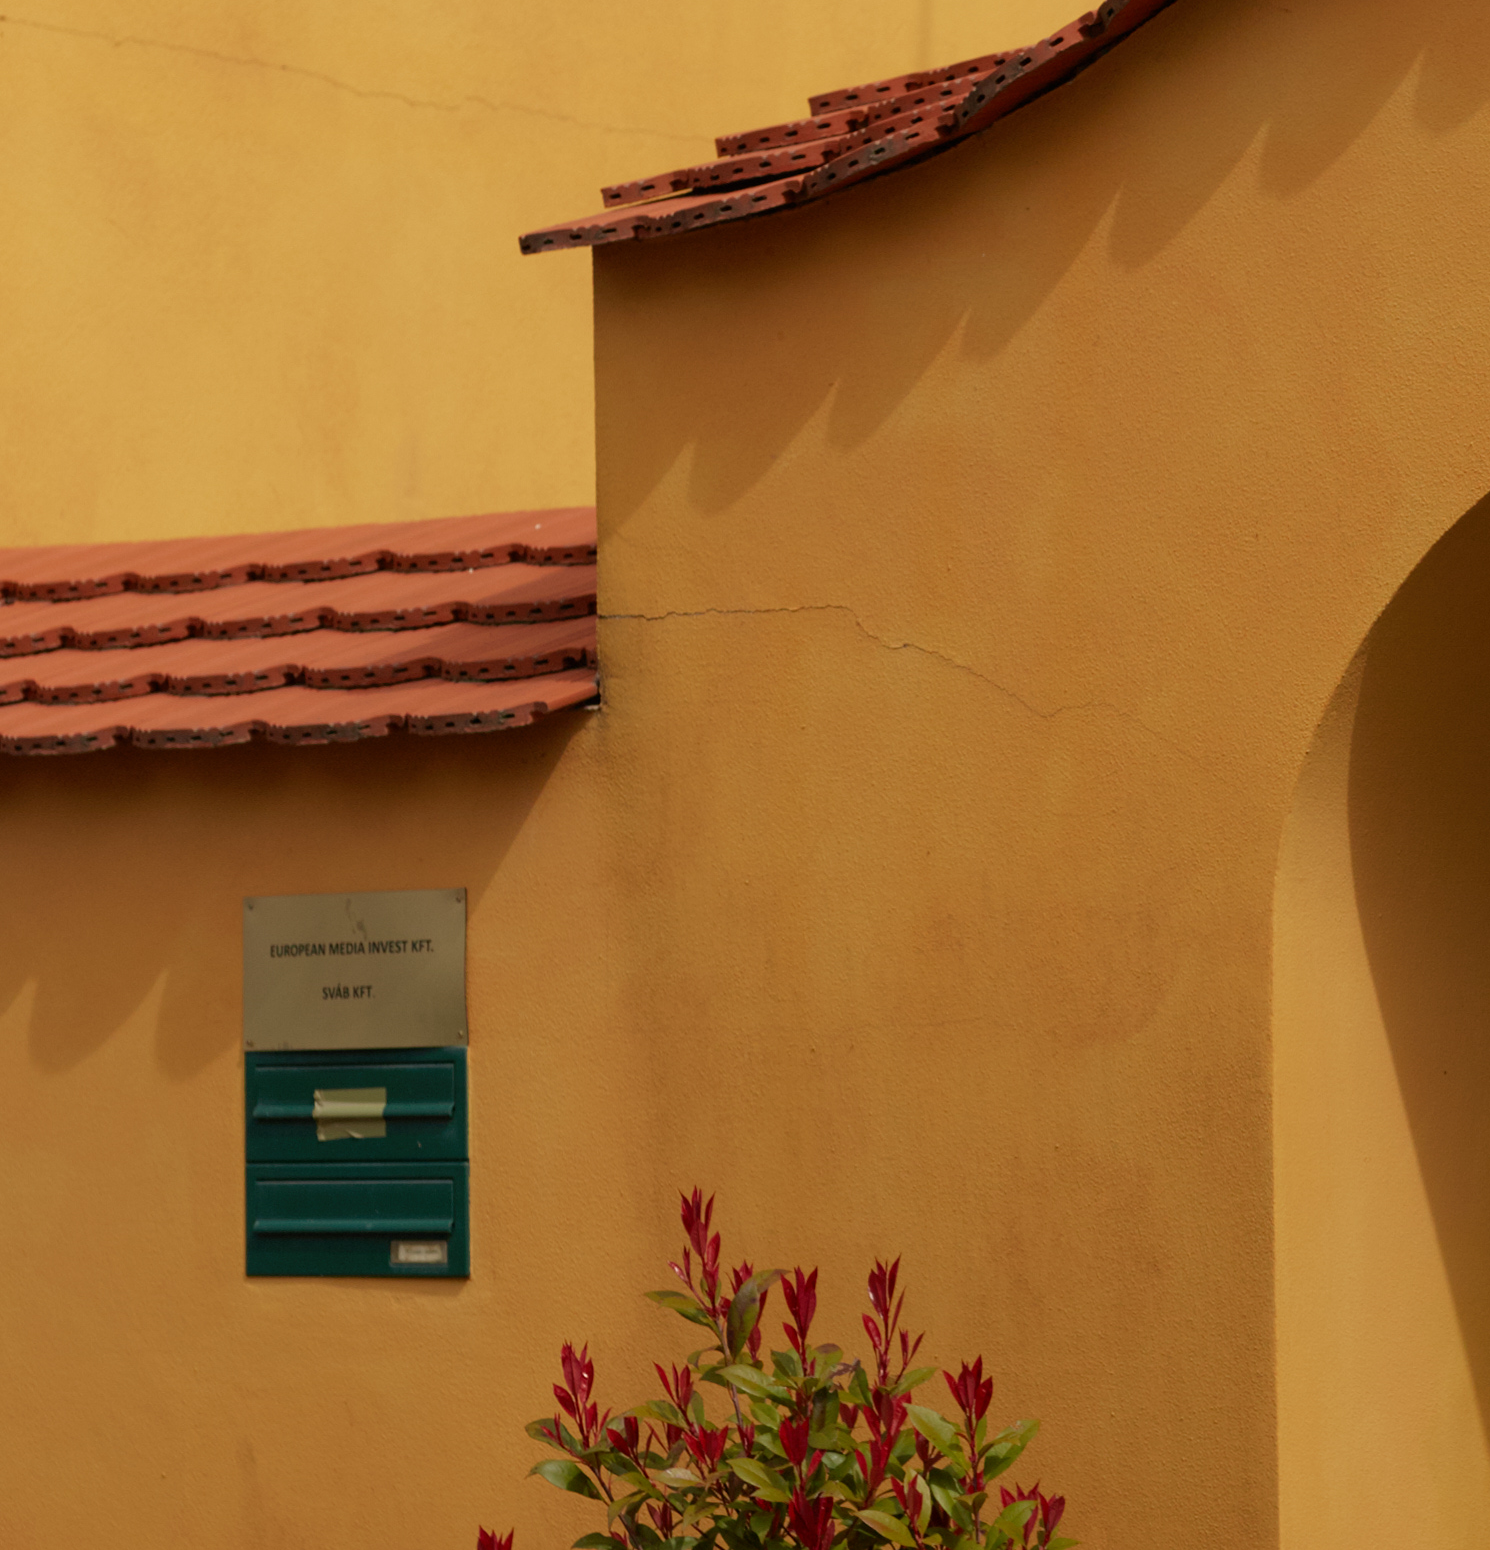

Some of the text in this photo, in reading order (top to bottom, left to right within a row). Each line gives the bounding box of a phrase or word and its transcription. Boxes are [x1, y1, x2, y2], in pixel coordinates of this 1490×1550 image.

[270, 939, 434, 958] EUROPEAN MEDIA INVEST KFT.
[322, 982, 350, 1000] SVÁB
